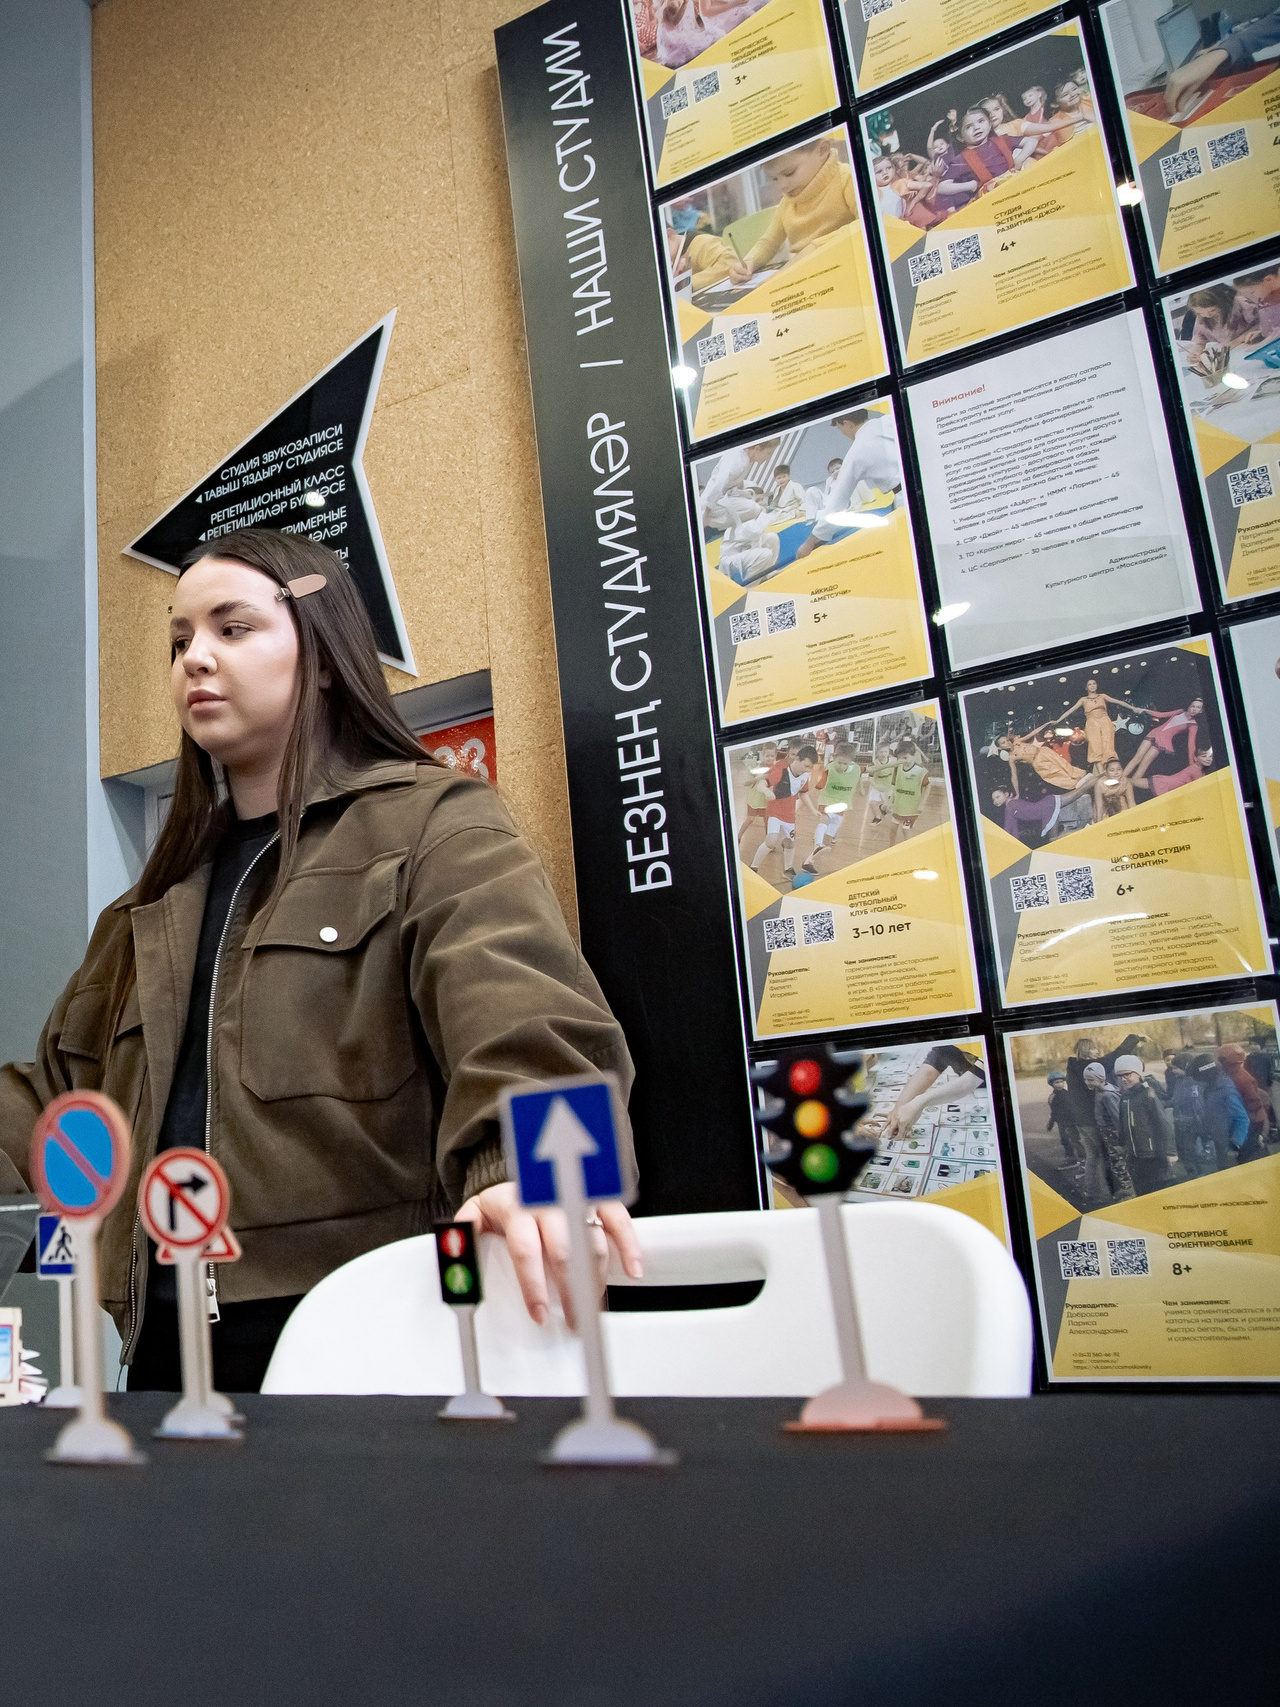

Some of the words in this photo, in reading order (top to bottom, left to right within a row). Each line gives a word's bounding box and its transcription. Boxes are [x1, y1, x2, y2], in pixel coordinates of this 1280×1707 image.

[734, 72, 747, 85] 3+
[543, 22, 596, 193] СТУДИИ
[993, 204, 1022, 220] СТУДИЯ
[995, 198, 1056, 227] ЭСТЕТИЧЕСКОГО
[996, 215, 1033, 234] РАЗВИТИЯ
[1034, 203, 1065, 220] «ДЖОЙ»
[999, 238, 1016, 252] 4+
[563, 198, 613, 336] НАШИ
[775, 325, 789, 338] 4+
[931, 384, 985, 408] Внимание!
[220, 456, 260, 481] СТУДИЯ
[262, 423, 343, 465] ЗВУКОЗАПИСИ
[204, 479, 240, 501] ТАВЫШ
[242, 464, 283, 488] ЯЗДЫРУ
[285, 439, 344, 469] СТУДИЯСЕ
[210, 478, 302, 525] РЕПЕТИЦИОННЫЙ
[304, 464, 345, 489] КЛАСС
[587, 412, 652, 691] СТУДИЯЛӘР
[810, 583, 838, 596] АЙКИДО
[813, 610, 827, 623] 5+
[615, 699, 672, 893] БЕЗНЕҢ
[1110, 850, 1155, 863] ЦИКОВАЯ
[1157, 844, 1191, 856] СТУДИЯ
[1110, 857, 1168, 872] «СЕРПАНТИН»
[847, 889, 880, 900] ДЕТСКИЙ
[1115, 882, 1135, 896] 6+
[848, 895, 897, 908] ФУТБОЛЬНЫЙ
[849, 908, 868, 917] КЛУБ
[869, 902, 906, 913] «ГОЛАСО»
[852, 923, 884, 938] 3–10
[888, 922, 911, 933] лет
[1166, 1229, 1228, 1239] СПОРТИВНОЕ
[1168, 1238, 1253, 1249] ОРИЕНТИРОВАНИЕ
[1171, 1262, 1192, 1275] 8+
